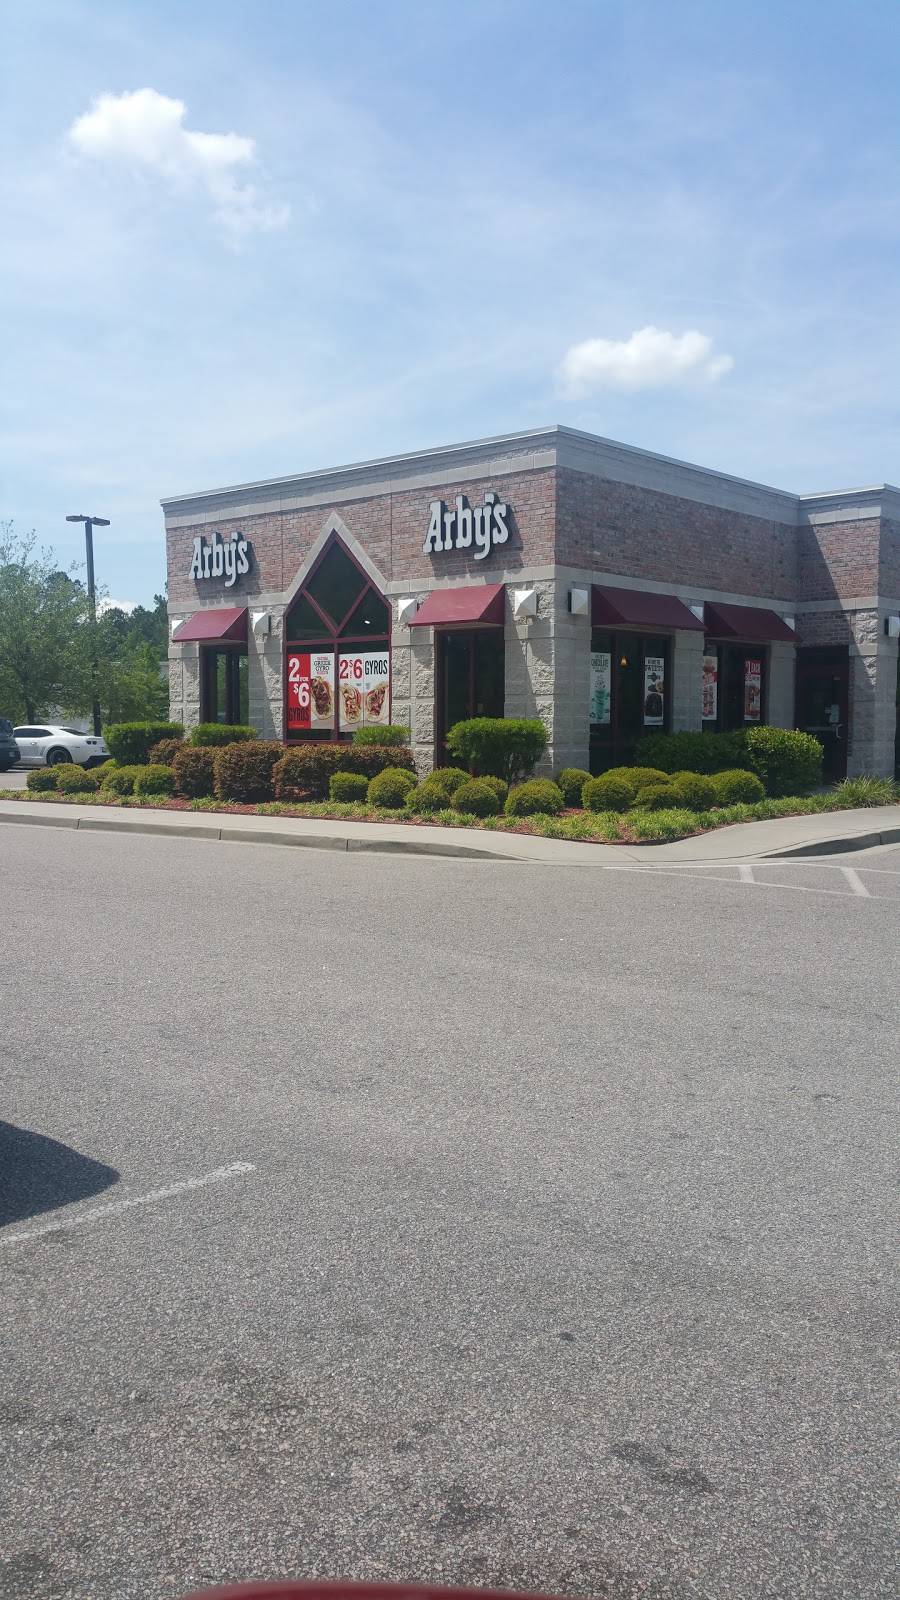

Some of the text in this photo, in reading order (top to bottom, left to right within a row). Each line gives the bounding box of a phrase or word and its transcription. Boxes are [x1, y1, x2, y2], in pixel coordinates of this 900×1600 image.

[423, 493, 509, 560] Arby's
[189, 532, 249, 588] Arby's
[365, 659, 388, 675] GYROS
[293, 683, 310, 707] $6
[289, 707, 310, 721] GYROS
